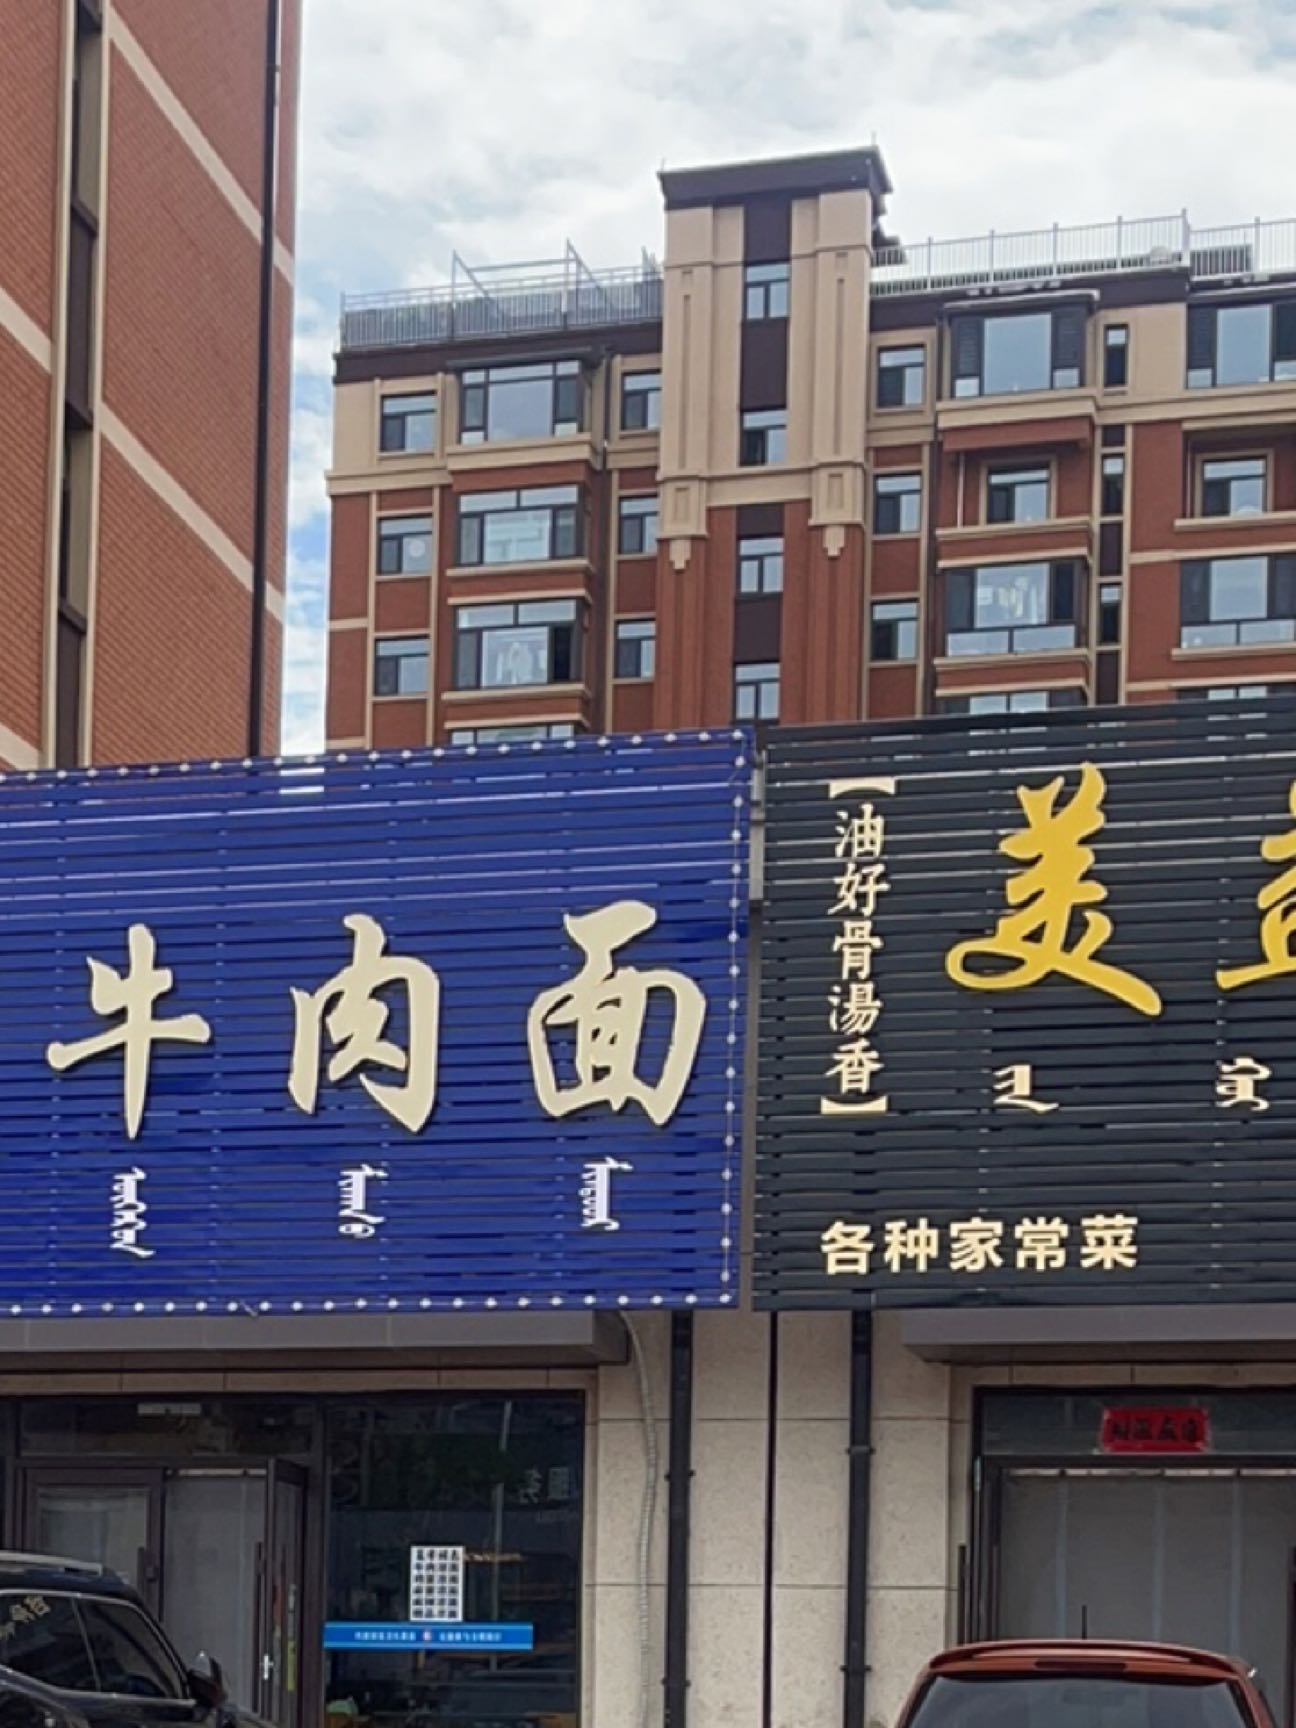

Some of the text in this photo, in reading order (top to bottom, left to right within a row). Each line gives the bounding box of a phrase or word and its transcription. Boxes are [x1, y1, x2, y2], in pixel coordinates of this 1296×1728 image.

[819, 1214, 1140, 1277] 各种家常菜
